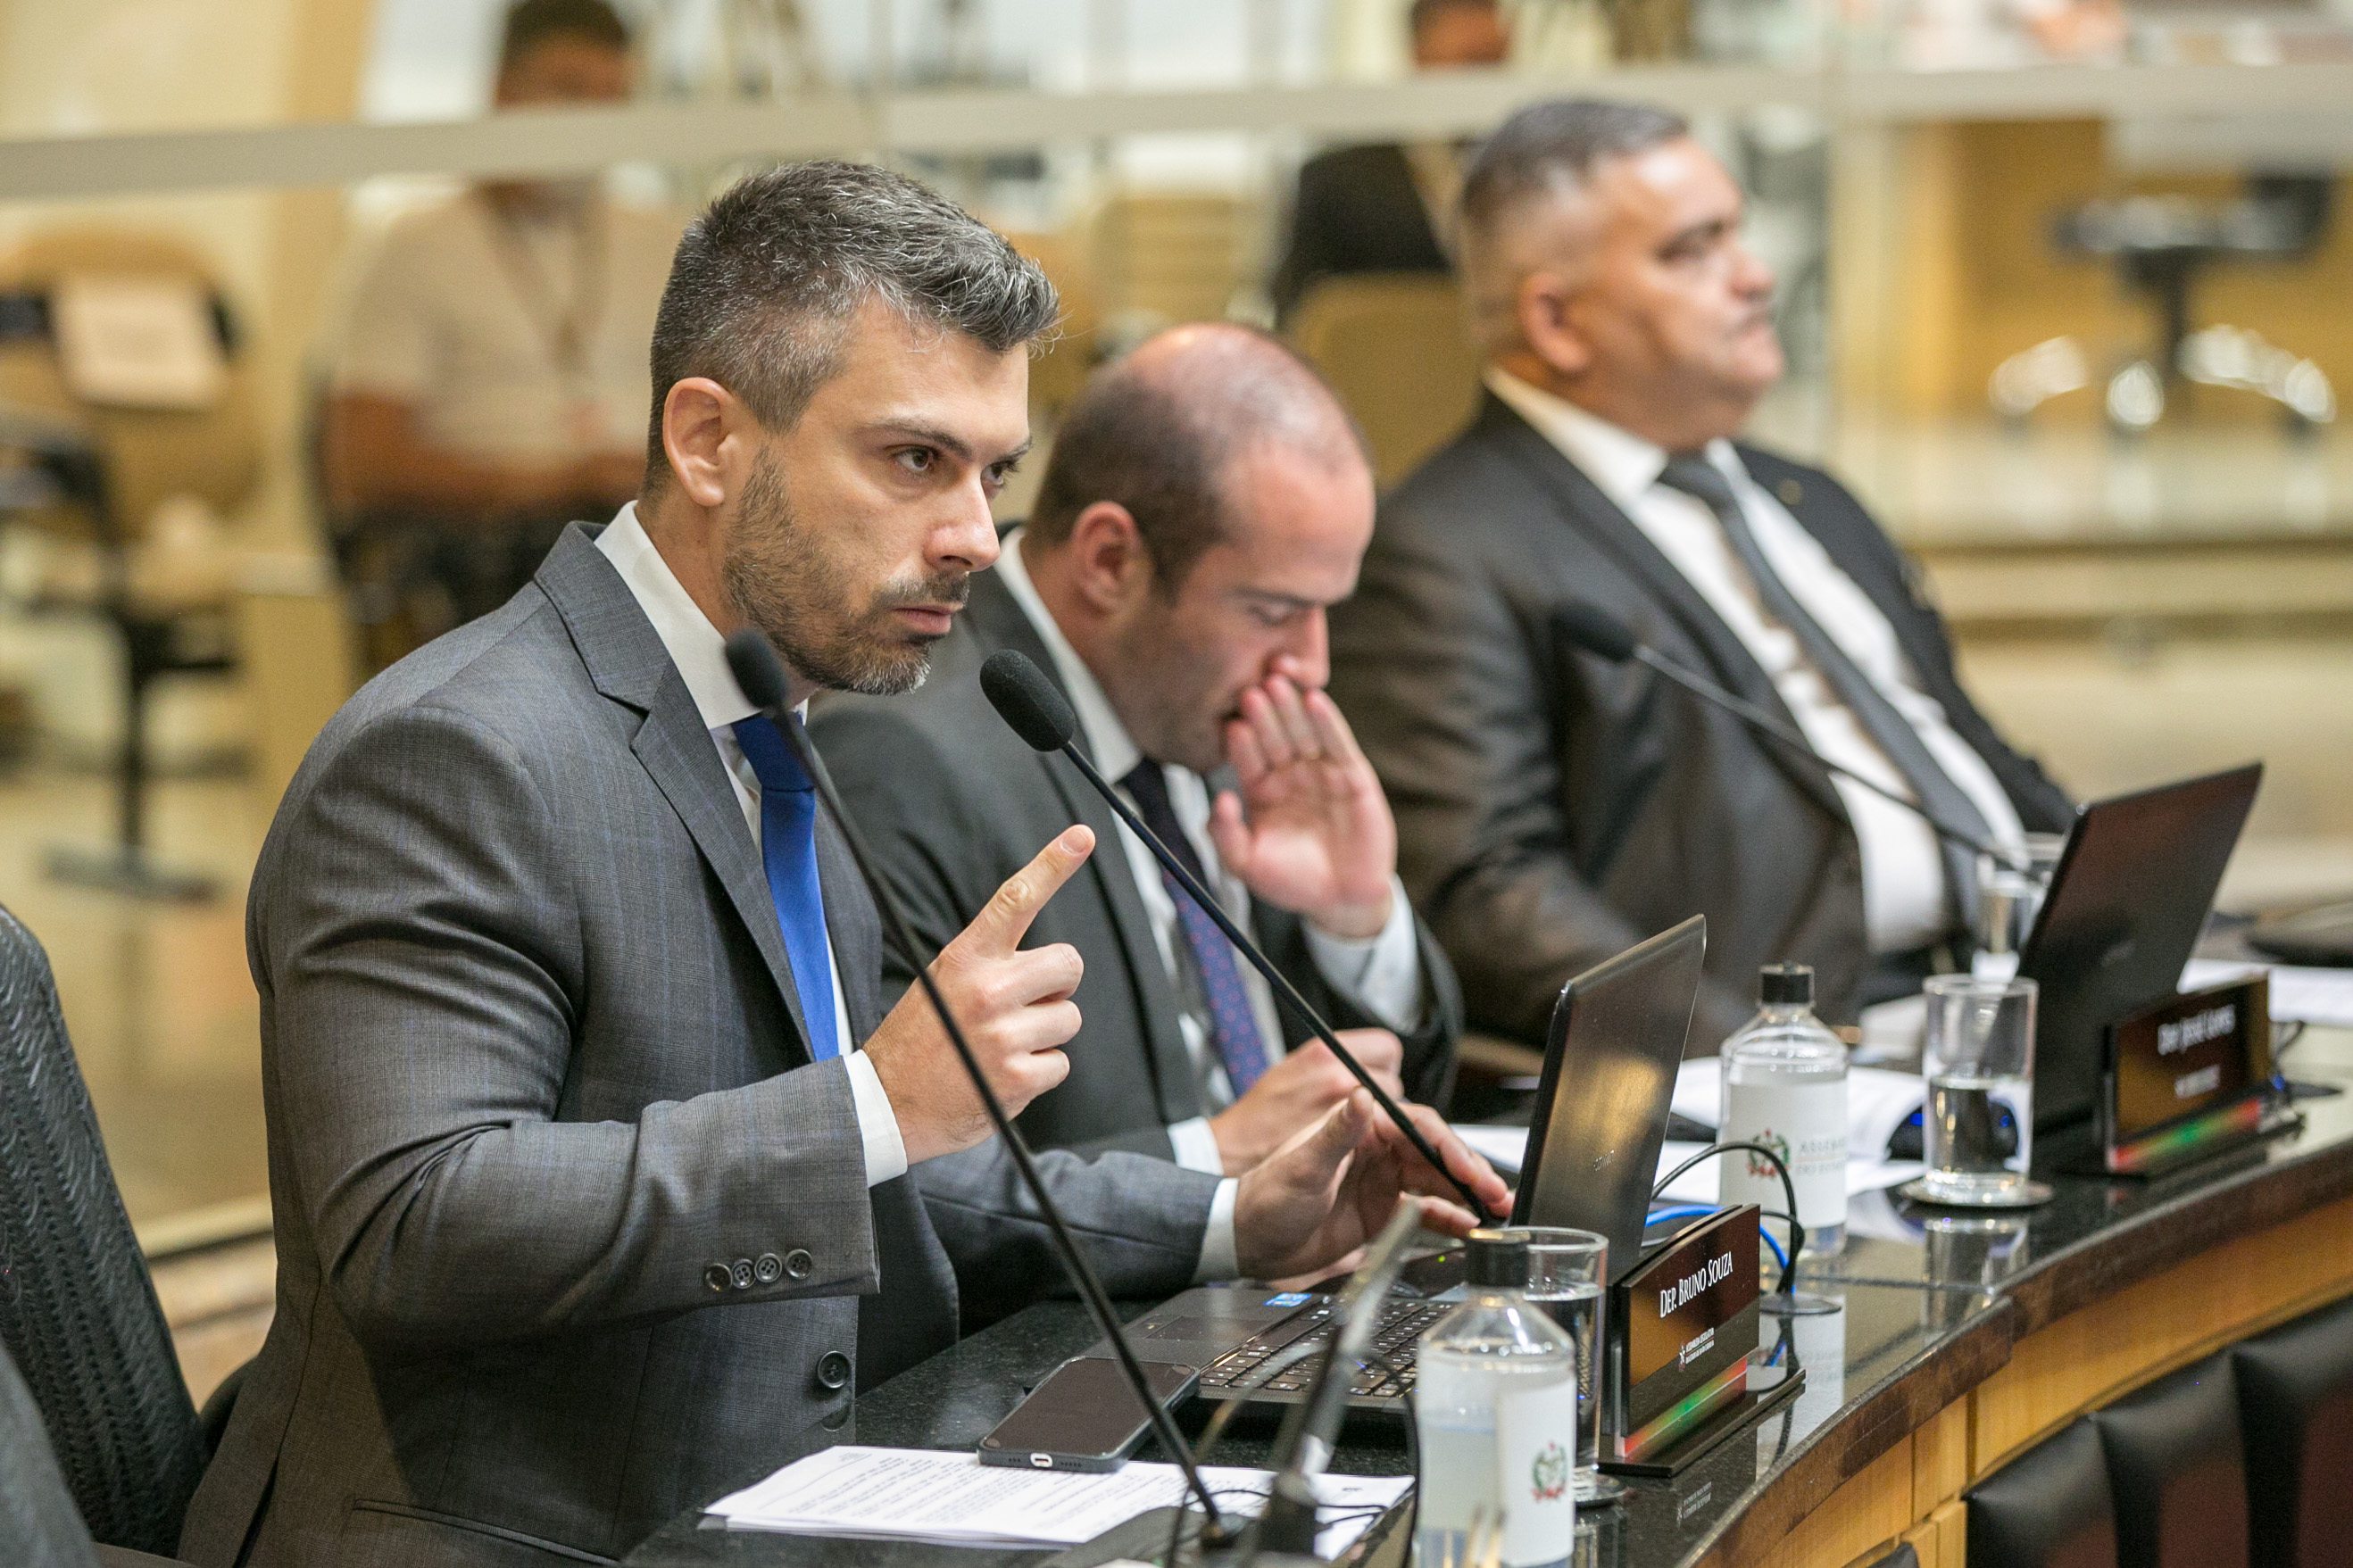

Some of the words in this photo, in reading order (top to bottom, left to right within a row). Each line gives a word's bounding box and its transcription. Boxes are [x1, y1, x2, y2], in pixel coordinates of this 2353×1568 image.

[1659, 1287, 1677, 1318] DEP.
[1678, 1267, 1707, 1307] BRUNO
[1708, 1250, 1734, 1287] SOUZA
